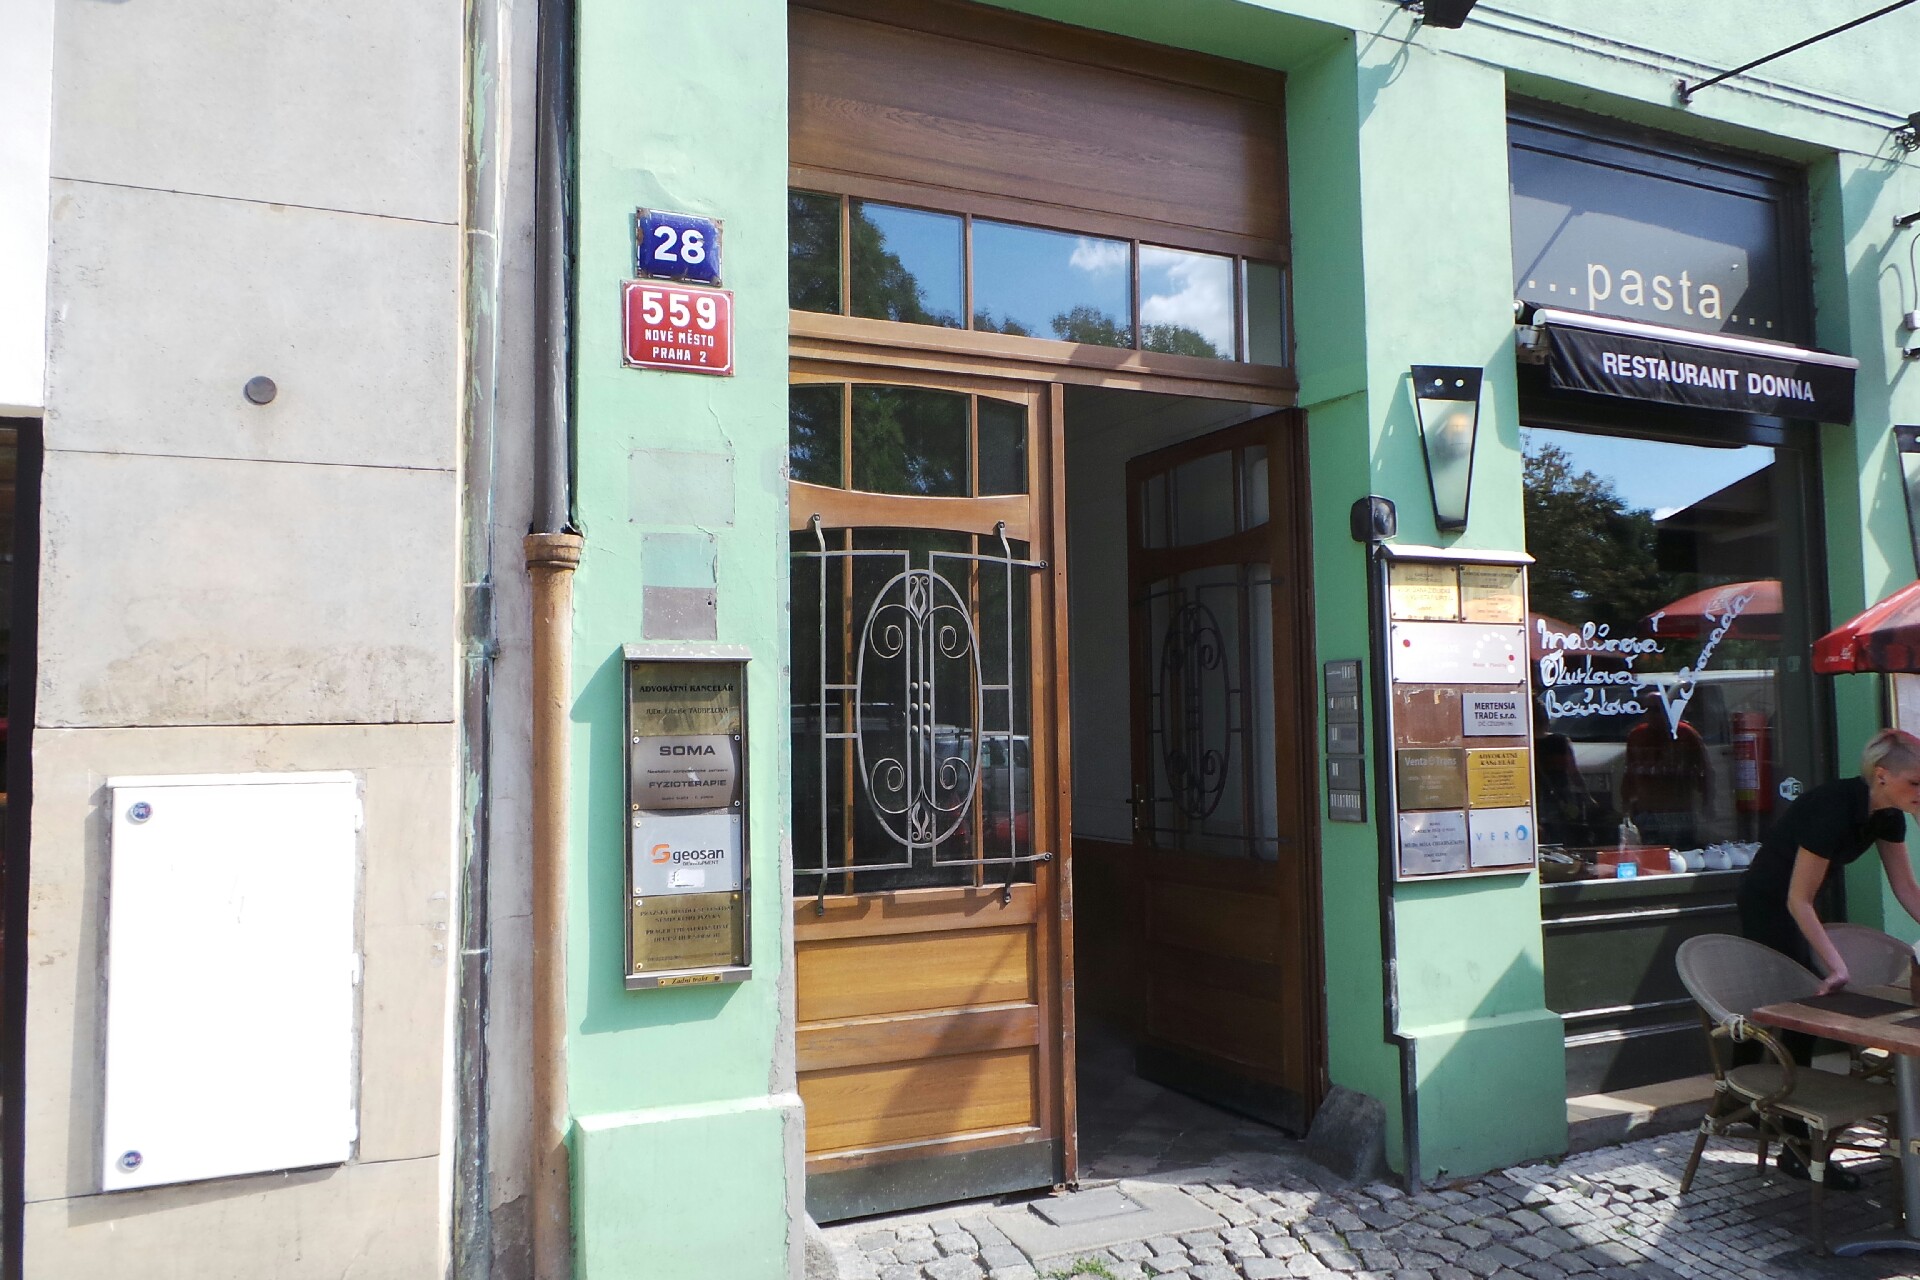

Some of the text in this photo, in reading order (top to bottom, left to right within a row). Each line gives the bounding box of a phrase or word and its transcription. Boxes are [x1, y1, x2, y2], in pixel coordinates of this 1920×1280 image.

[654, 225, 706, 264] 28
[642, 290, 717, 330] 559
[645, 327, 714, 347] NOVÉ MĚSTO
[652, 347, 707, 363] PRAHA 2
[1602, 352, 1815, 402] RESTAURANT DONNA
[1474, 702, 1516, 710] MERTENSIA
[1474, 711, 1499, 720] TRADE
[659, 745, 716, 757] SOMA
[648, 779, 727, 789] FYZIOTERAPIE
[672, 849, 725, 864] geosan
